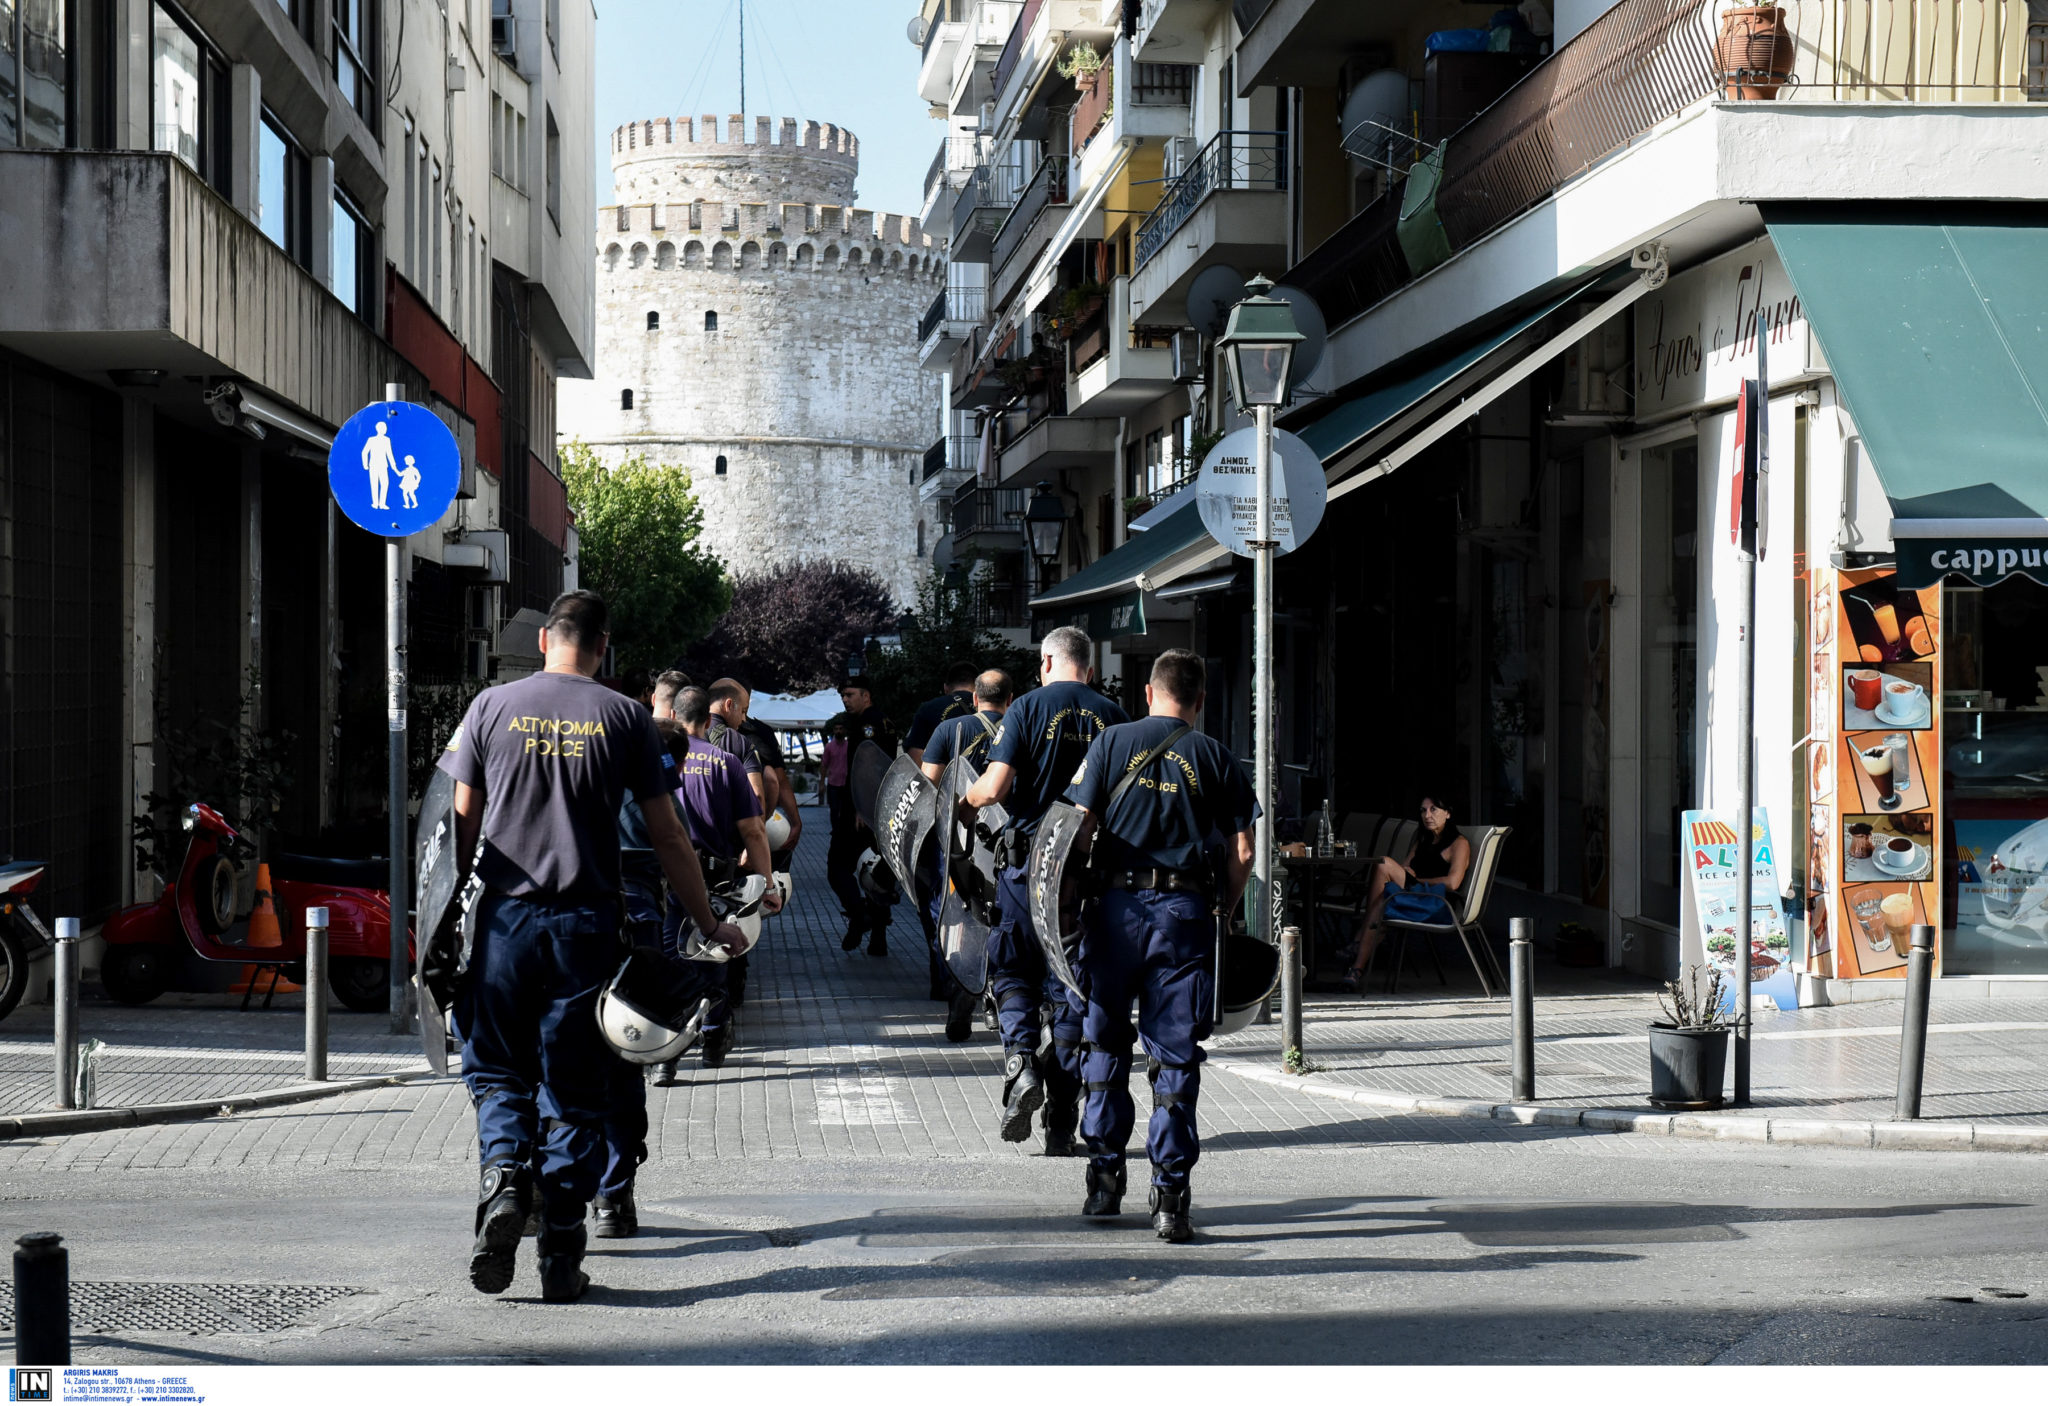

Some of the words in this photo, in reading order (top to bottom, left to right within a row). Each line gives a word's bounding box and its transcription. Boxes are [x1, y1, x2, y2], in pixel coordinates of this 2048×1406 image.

[1221, 457, 1248, 465] ΔΗΜΟΣ
[508, 716, 606, 737] ΑΣΤΥΝΟΜΙΑ
[1075, 708, 1105, 732] ΑΣΤΥΝΟ
[1163, 750, 1199, 796] ΣΤΥΝΟΜΙΑ
[1138, 777, 1178, 793] POLICE
[1695, 846, 1773, 870] ALA
[1699, 872, 1719, 880] ICE
[1725, 869, 1771, 878] CRMS
